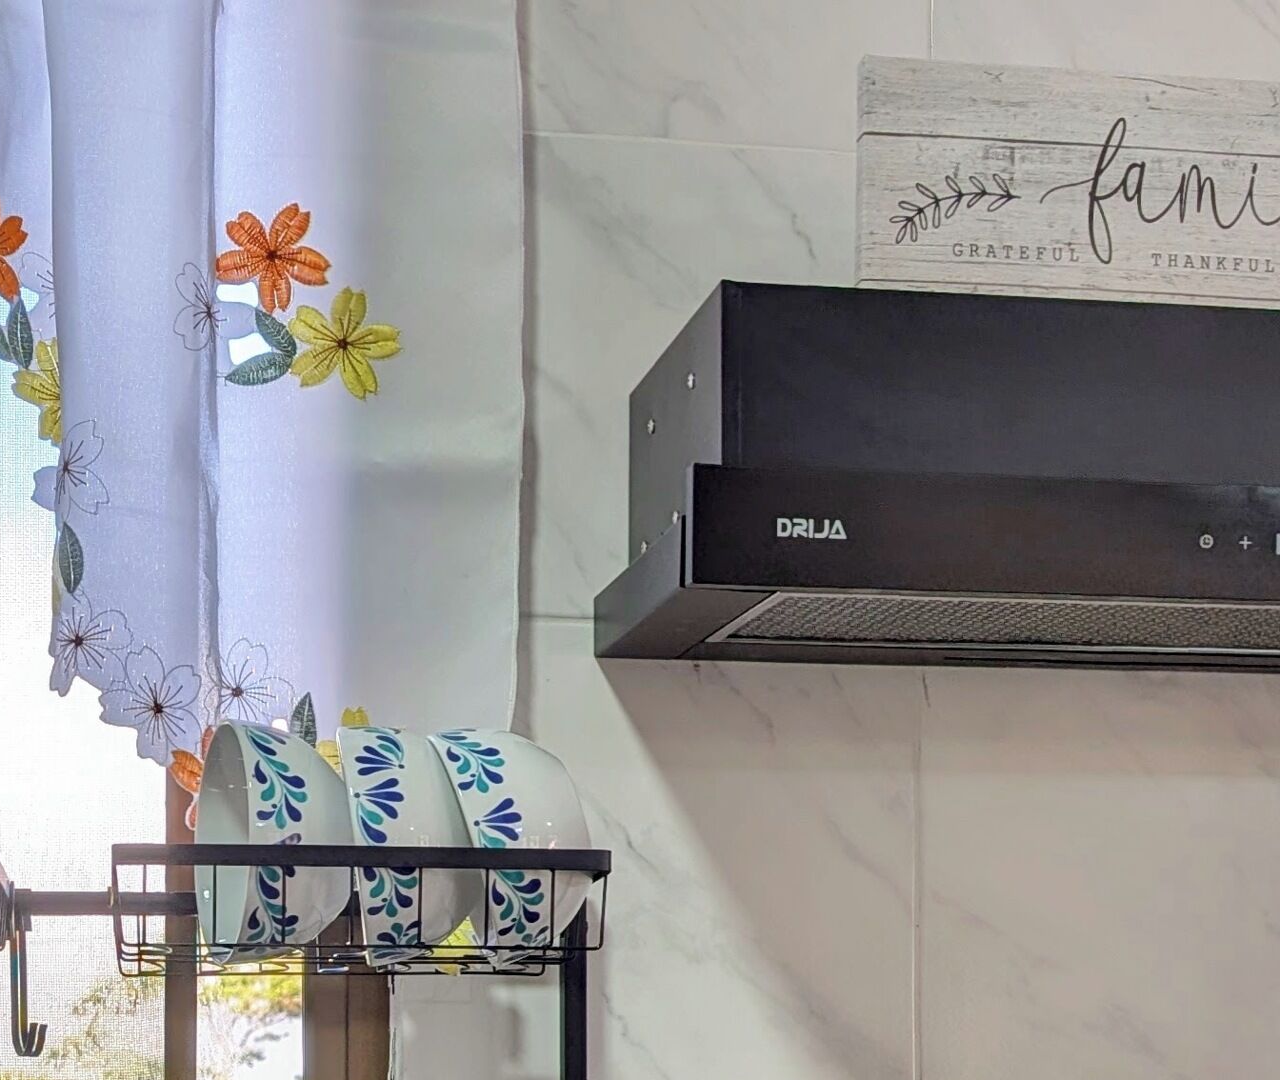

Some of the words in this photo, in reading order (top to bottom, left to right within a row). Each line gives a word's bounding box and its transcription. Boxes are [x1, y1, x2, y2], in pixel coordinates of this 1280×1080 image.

[952, 242, 1080, 262] GRATEFUL
[1151, 252, 1276, 273] THANKFUL
[777, 518, 847, 539] DRIJA
